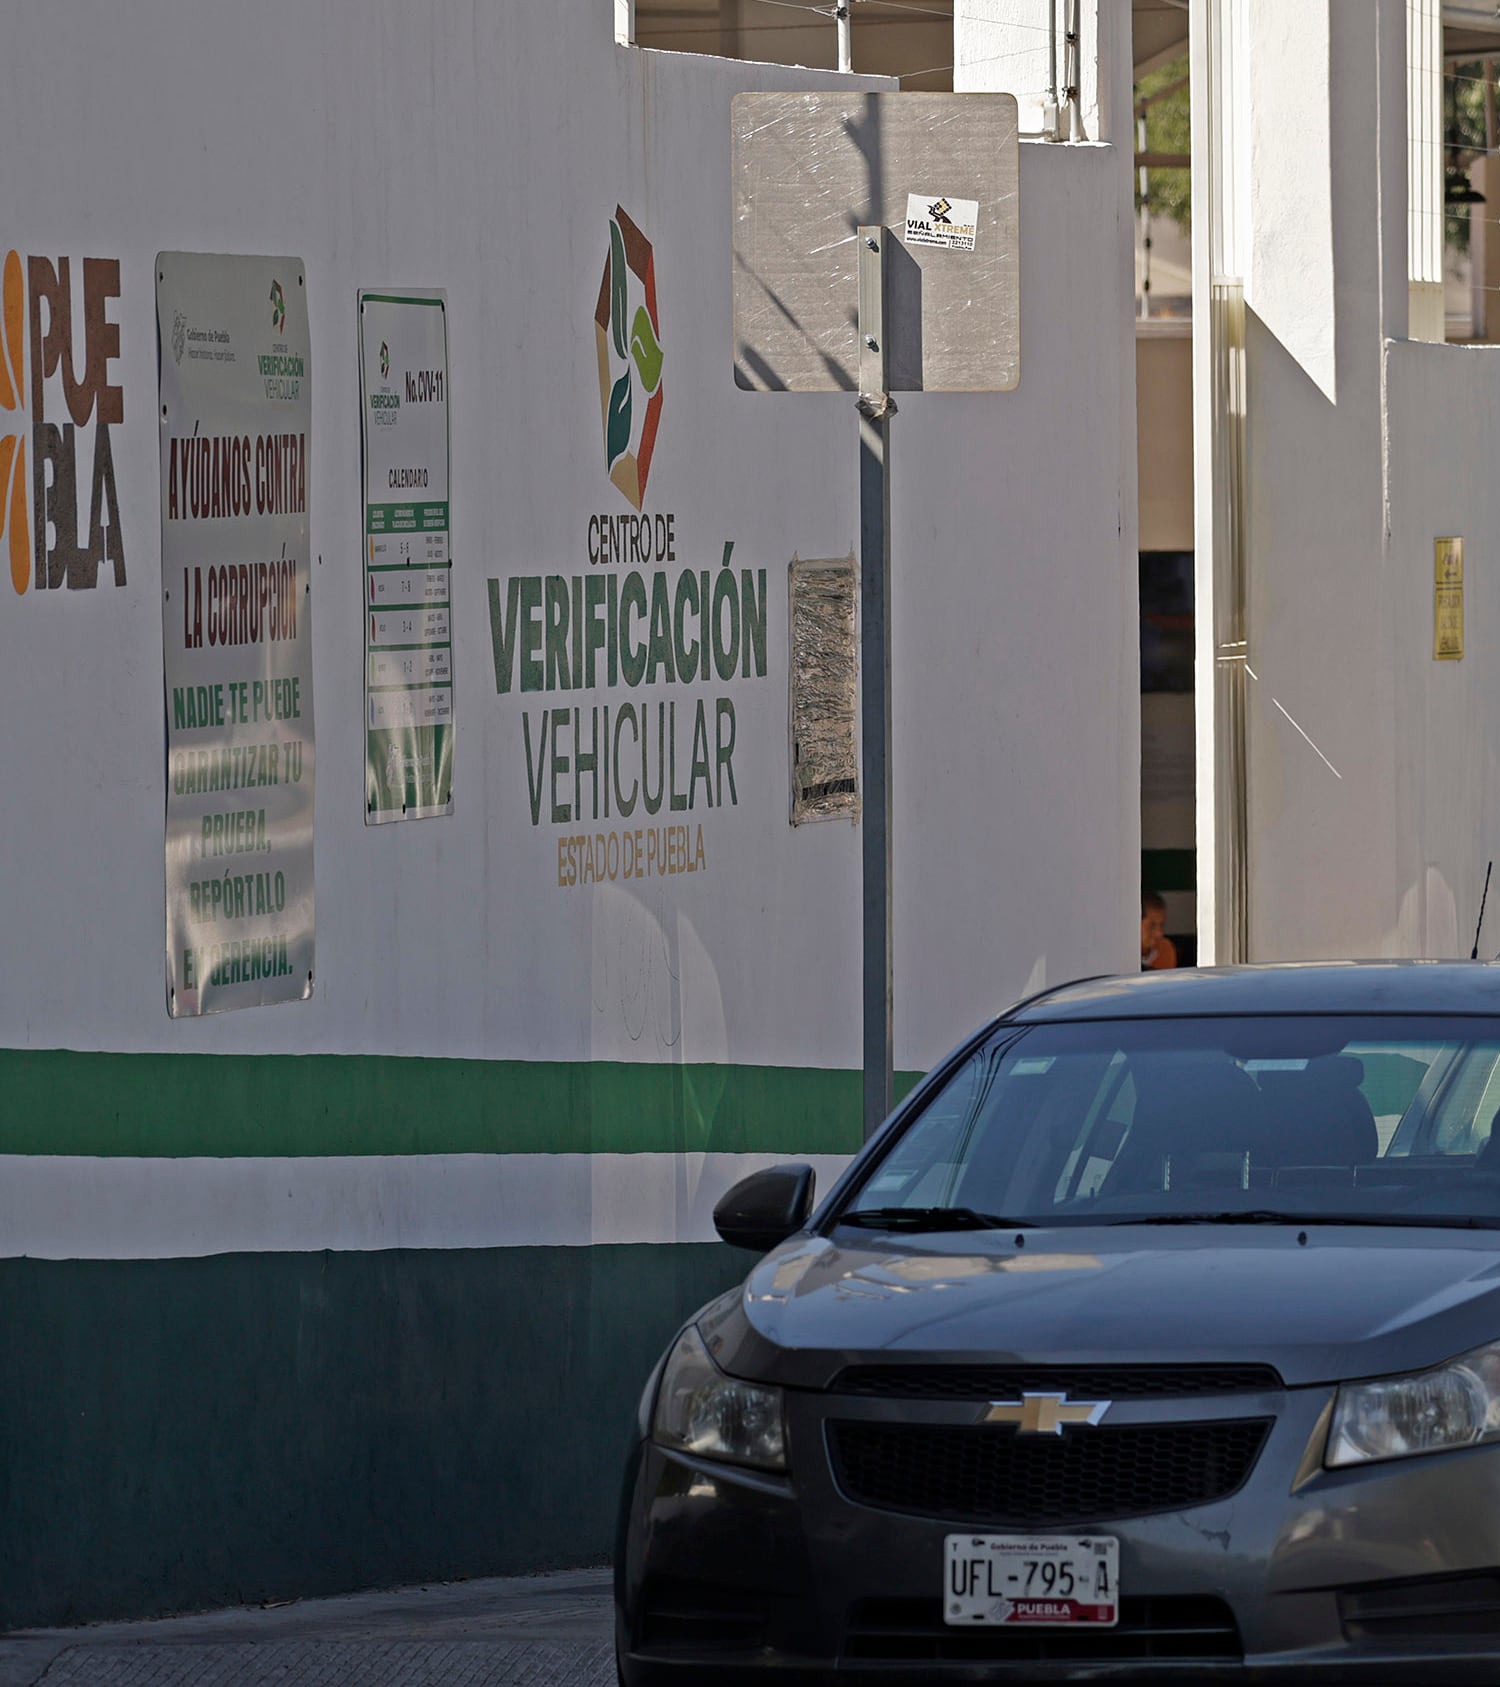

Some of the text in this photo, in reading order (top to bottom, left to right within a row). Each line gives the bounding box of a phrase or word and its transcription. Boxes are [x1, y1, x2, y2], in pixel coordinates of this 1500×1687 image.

[907, 220, 975, 235] VIAL XTREME
[28, 256, 123, 427] PUE
[257, 352, 304, 377] VERIFICACIÓN
[264, 378, 299, 400] VEHICULAR
[169, 420, 305, 520] AYÚDANOS CONTRA
[388, 468, 429, 488] CALENDARIO
[34, 422, 127, 590] BLA
[588, 513, 676, 565] CENTRO DE
[184, 542, 297, 649] LA CORRUPCIÓN
[487, 541, 767, 694] VERIFICACIÓN
[173, 677, 301, 730] NADIE TE PUEDE
[173, 741, 302, 796] GARANTIZAR TU
[522, 697, 738, 826] VEHICULAR
[201, 808, 272, 858] PRUEBA,
[558, 824, 706, 887] ESTADO DE PUEBLA
[190, 868, 285, 925] REPÓRTALO
[210, 935, 293, 988] GERENCIA.
[990, 1542, 1067, 1552] Gobierno de Puebla
[1017, 1603, 1071, 1615] PUEBLA
